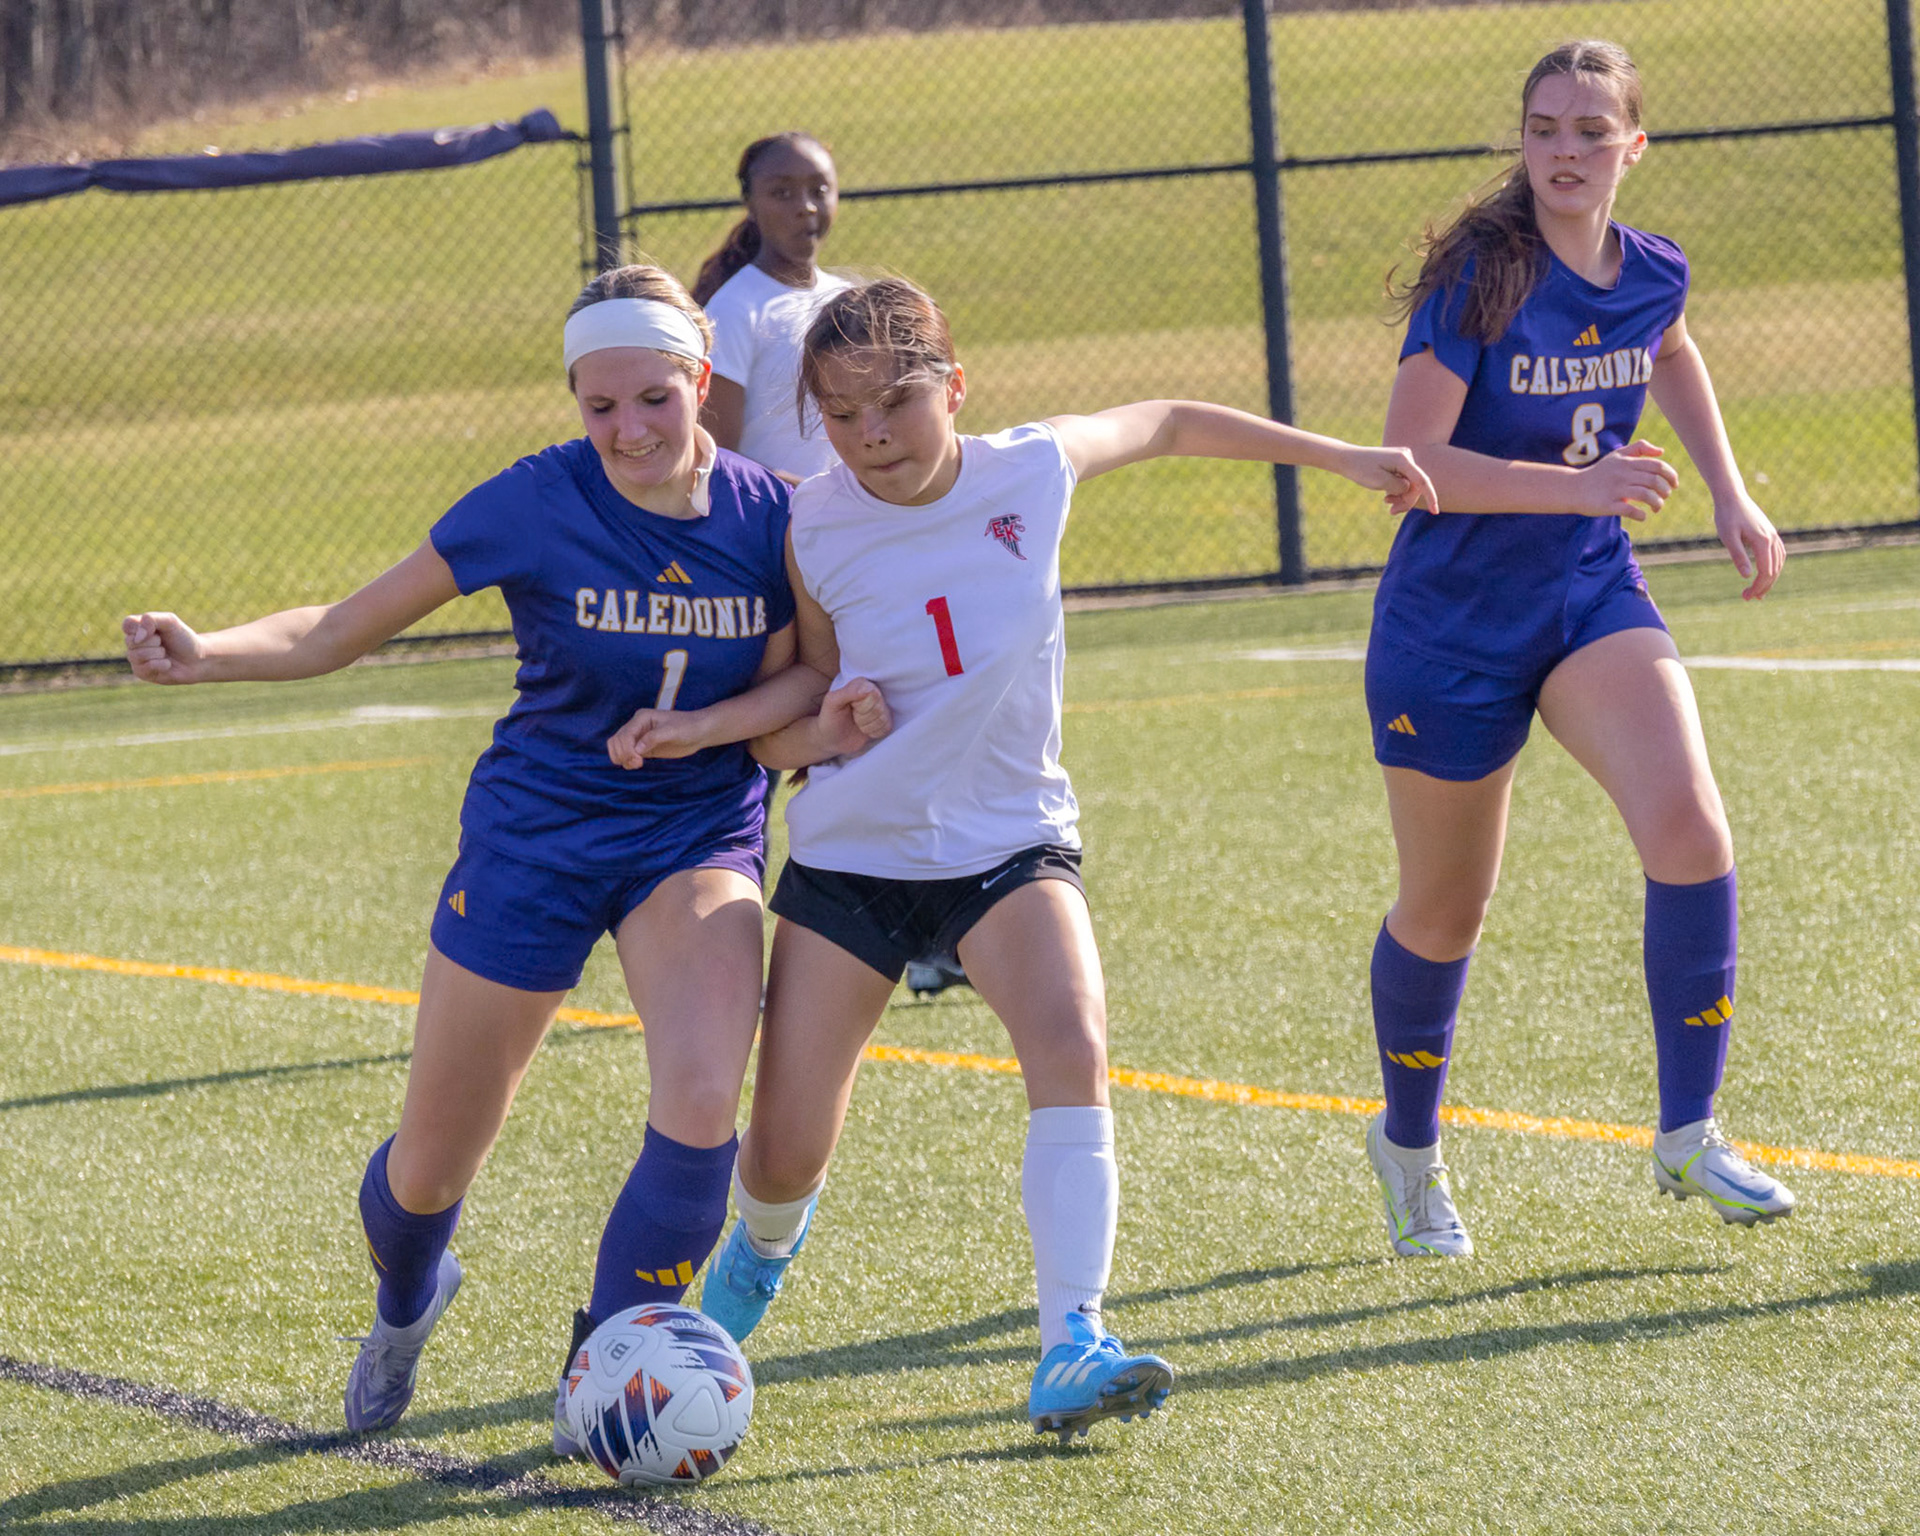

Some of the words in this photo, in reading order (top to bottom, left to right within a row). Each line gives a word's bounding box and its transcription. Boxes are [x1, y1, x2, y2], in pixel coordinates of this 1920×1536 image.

[1510, 346, 1653, 394] CALEDONIA
[1563, 403, 1605, 465] 8
[991, 522, 1019, 542] EK
[576, 588, 767, 639] CALEDONIA
[925, 597, 963, 676] 1
[656, 649, 688, 710] 1
